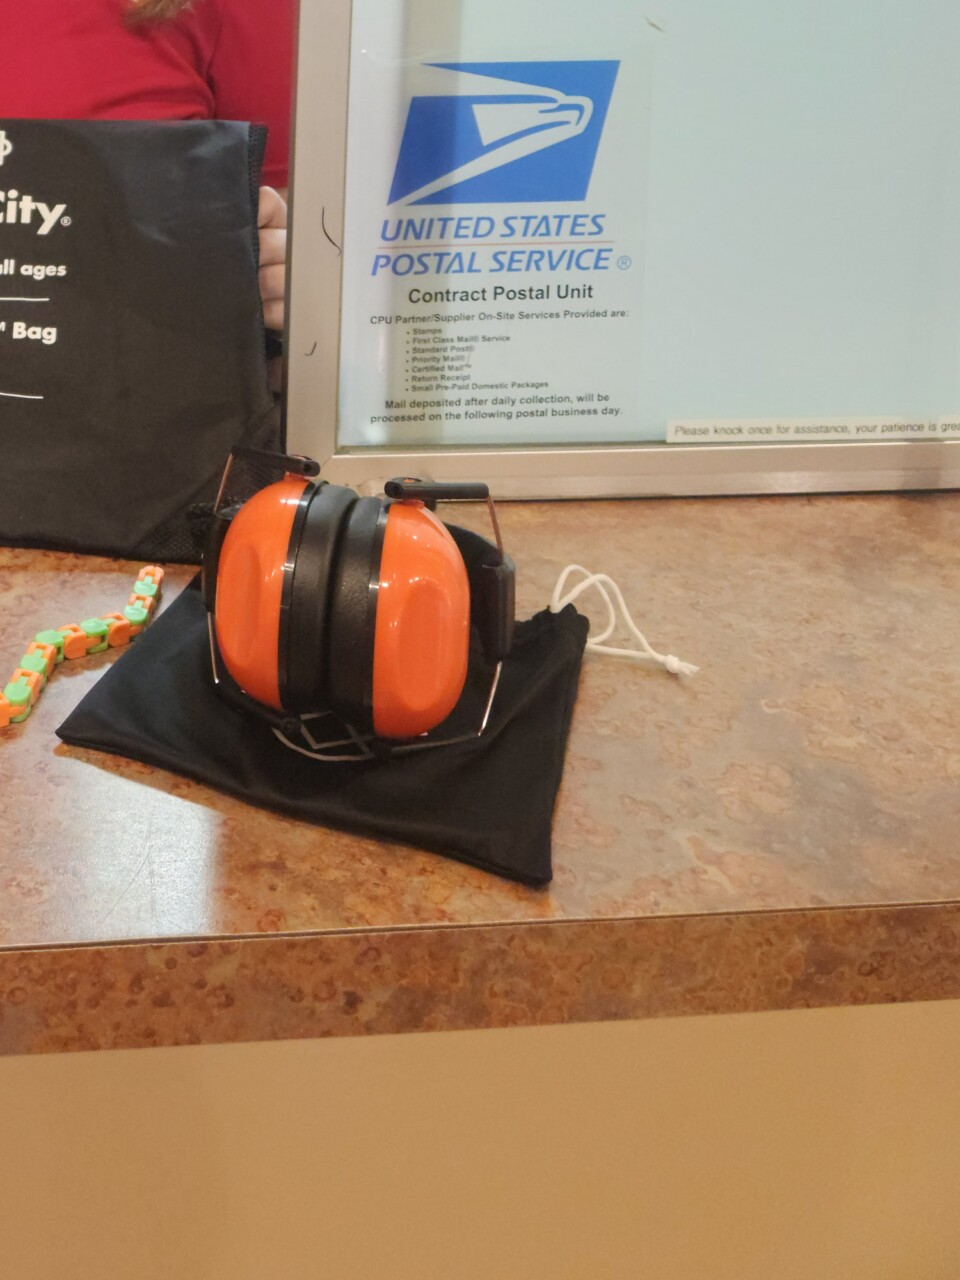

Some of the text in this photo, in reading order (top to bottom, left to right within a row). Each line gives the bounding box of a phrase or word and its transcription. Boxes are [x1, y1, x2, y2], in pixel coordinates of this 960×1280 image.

[380, 214, 606, 242] UNITED STATES
[371, 252, 482, 276] POSTAL
[20, 264, 67, 280] ages
[408, 284, 593, 304] Contract Postal Unit
[370, 310, 630, 325] CPU Partner/Supplier On-Site Services Provided are:
[13, 322, 57, 345] Bag
[412, 328, 442, 336] Stamps
[412, 337, 431, 345] First
[433, 336, 455, 344] Class
[481, 334, 511, 342] Service
[412, 346, 448, 354] Standard
[412, 356, 441, 364] Priority
[411, 365, 445, 373] Certified
[411, 374, 471, 383] Return Receipt
[411, 381, 549, 392] Small Pre-Paid Domestic Packages
[385, 393, 610, 410] Mail deposited after daily collection, will be
[370, 412, 425, 424] processed
[428, 413, 442, 421] on
[444, 411, 461, 420] the
[464, 409, 513, 420] following
[515, 408, 548, 419] postal
[551, 407, 598, 417] business
[674, 425, 710, 436] Please
[713, 425, 743, 435] knock
[747, 426, 773, 435] once
[776, 424, 790, 435] for
[794, 424, 851, 435] assistance,
[855, 423, 878, 435] your
[881, 422, 925, 434] patience
[928, 421, 937, 432] is
